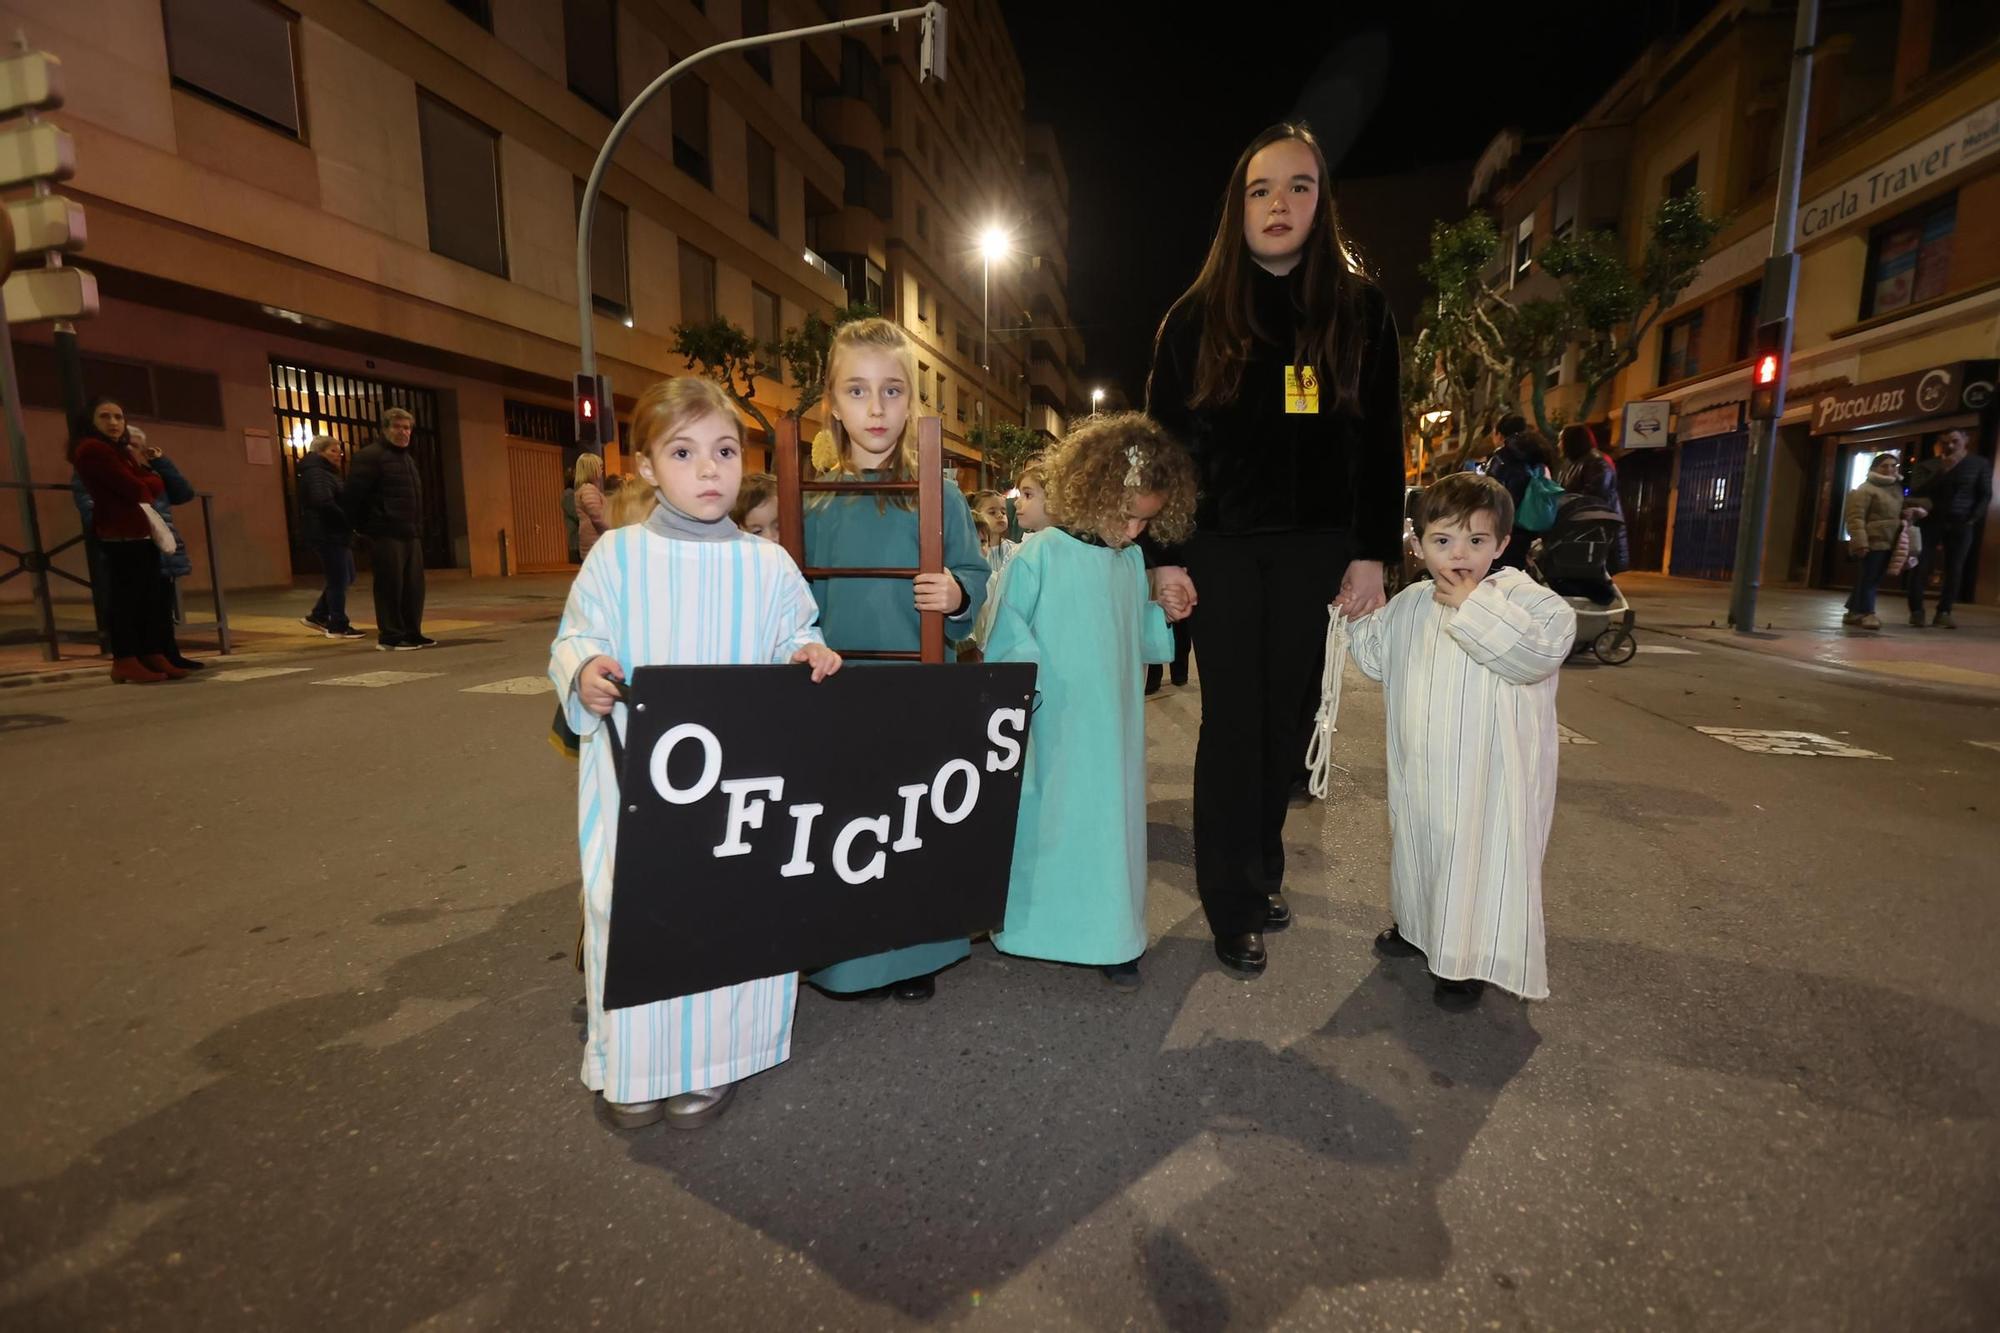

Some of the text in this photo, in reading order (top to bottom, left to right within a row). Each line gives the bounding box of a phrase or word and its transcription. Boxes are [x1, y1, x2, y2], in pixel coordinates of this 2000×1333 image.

[1802, 142, 1957, 237] Carla Traver
[650, 707, 1026, 885] OFICIOS
